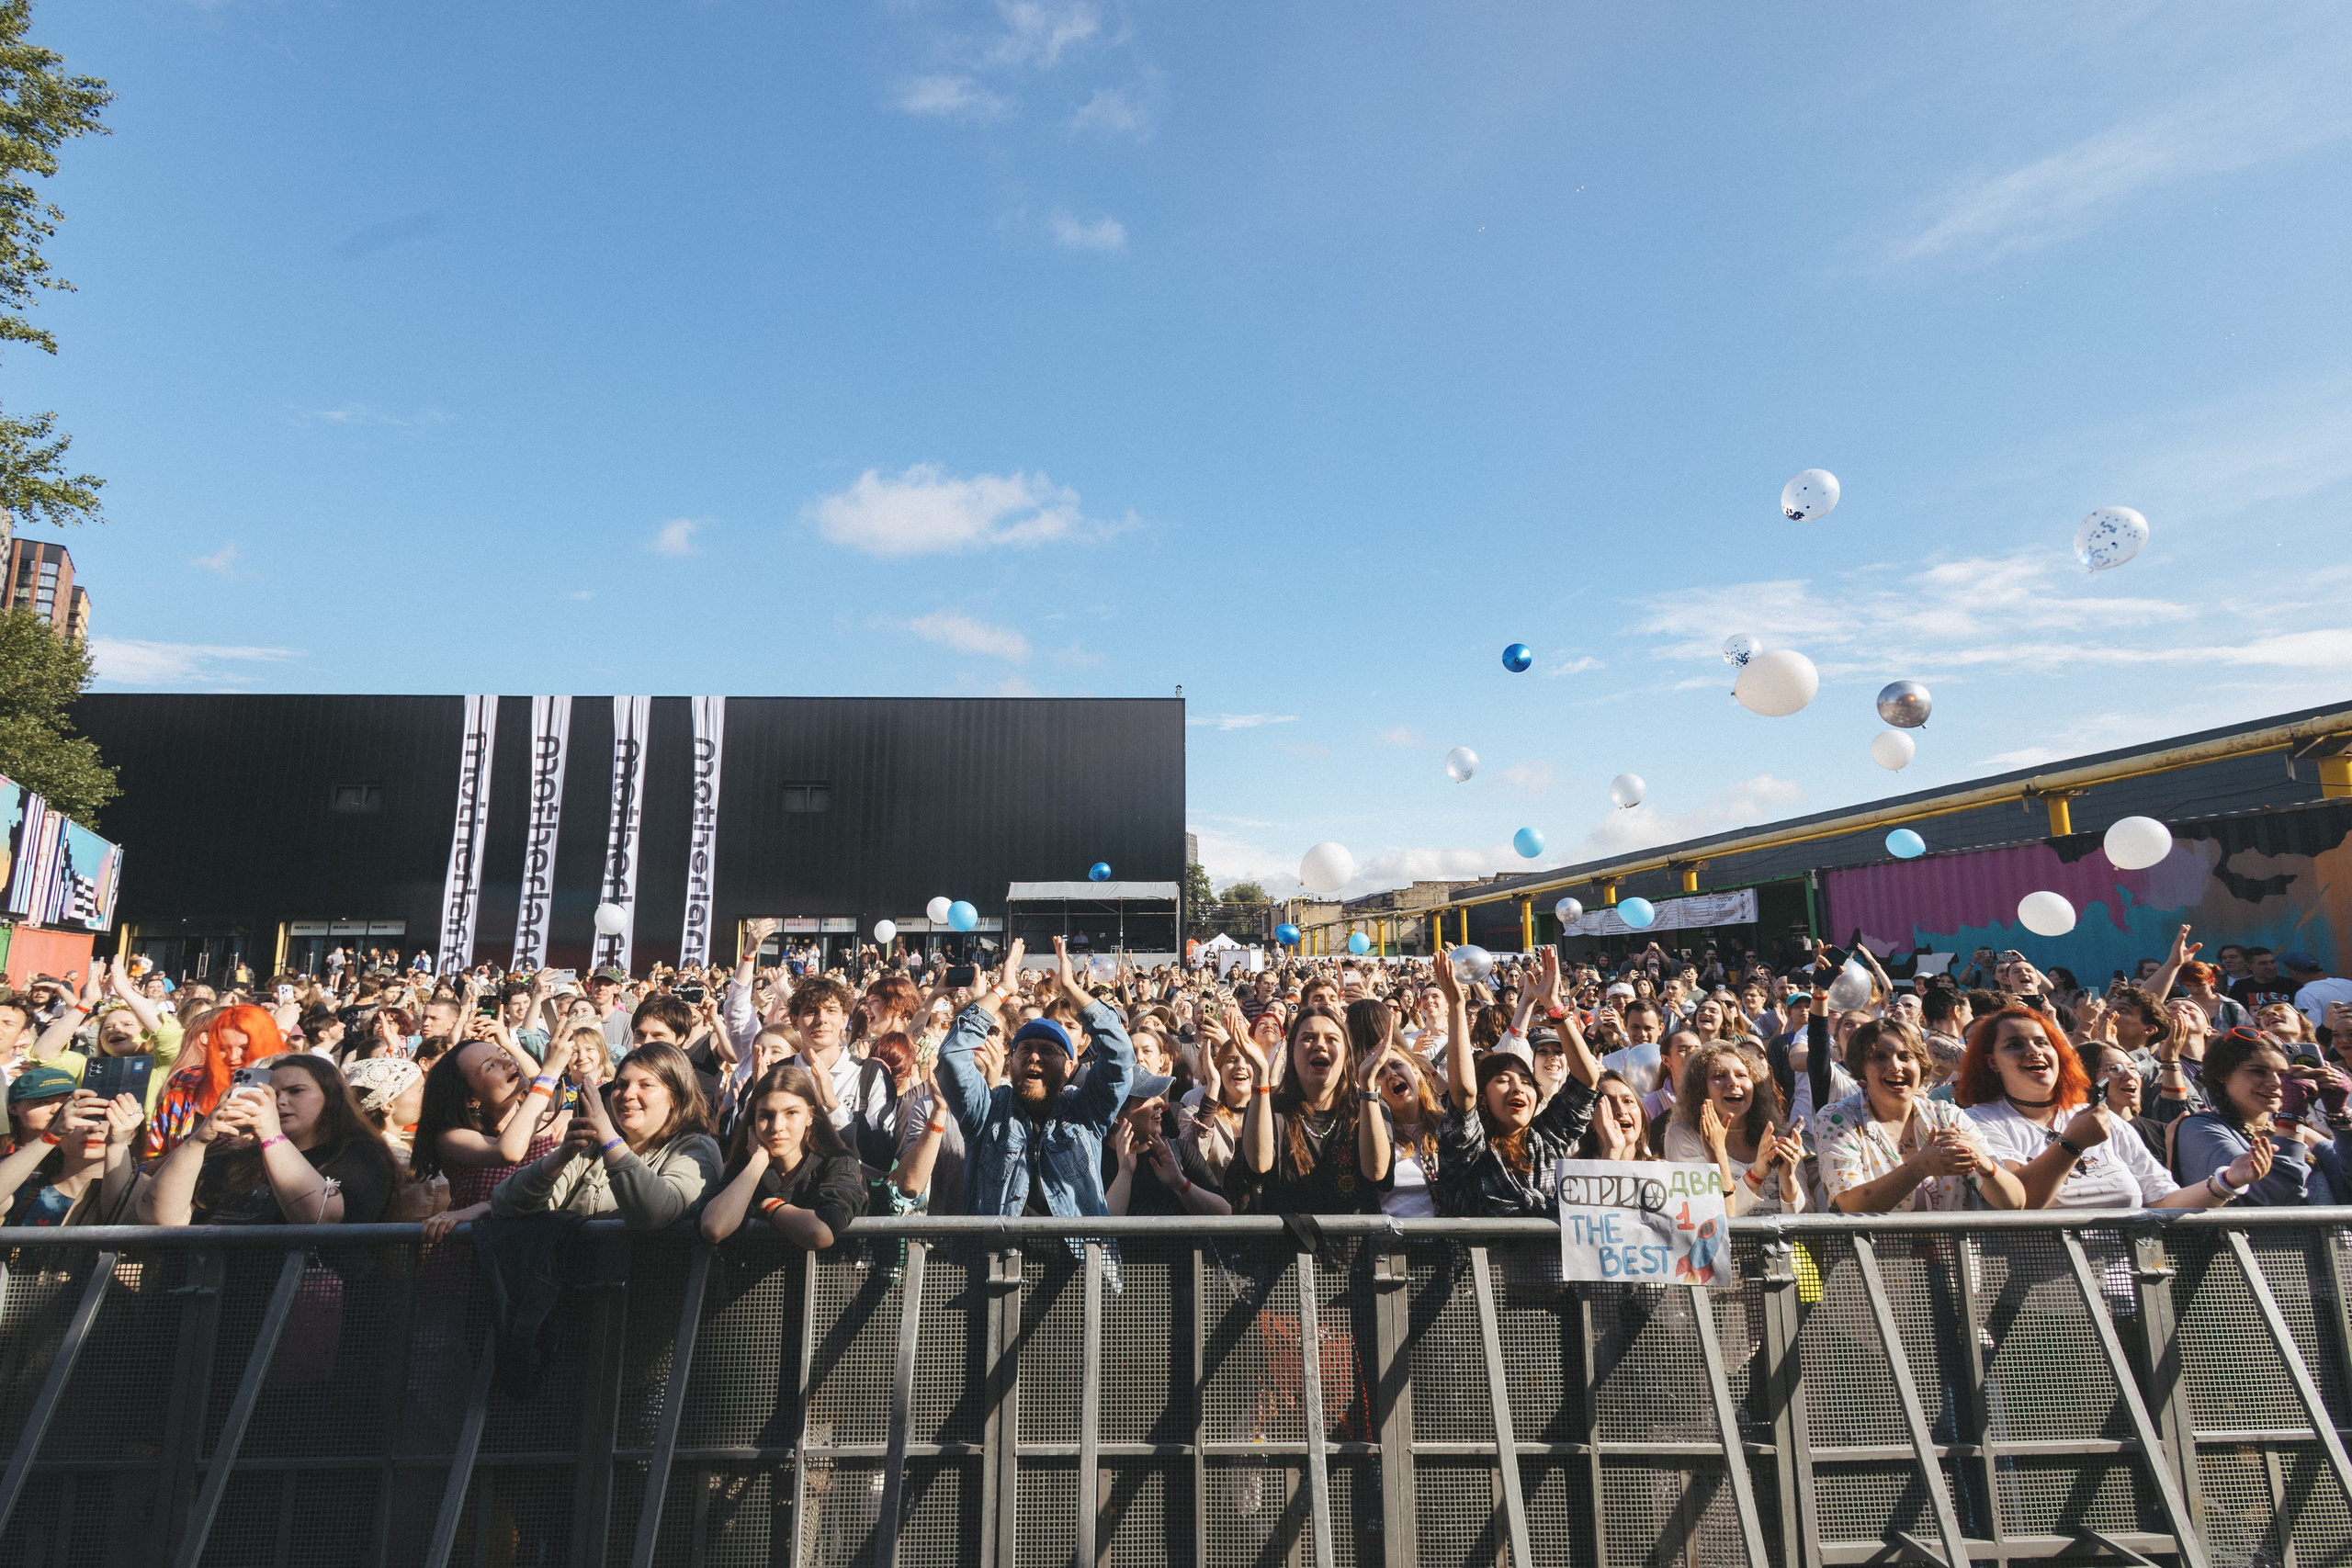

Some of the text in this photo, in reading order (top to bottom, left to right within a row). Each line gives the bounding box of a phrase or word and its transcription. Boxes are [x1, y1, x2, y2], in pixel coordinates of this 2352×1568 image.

[598, 739, 639, 970] motherln
[1668, 1170, 1724, 1198] ДВА
[1569, 1213, 1623, 1246] THE
[1676, 1201, 1696, 1230] 1
[1599, 1245, 1673, 1278] BEST
